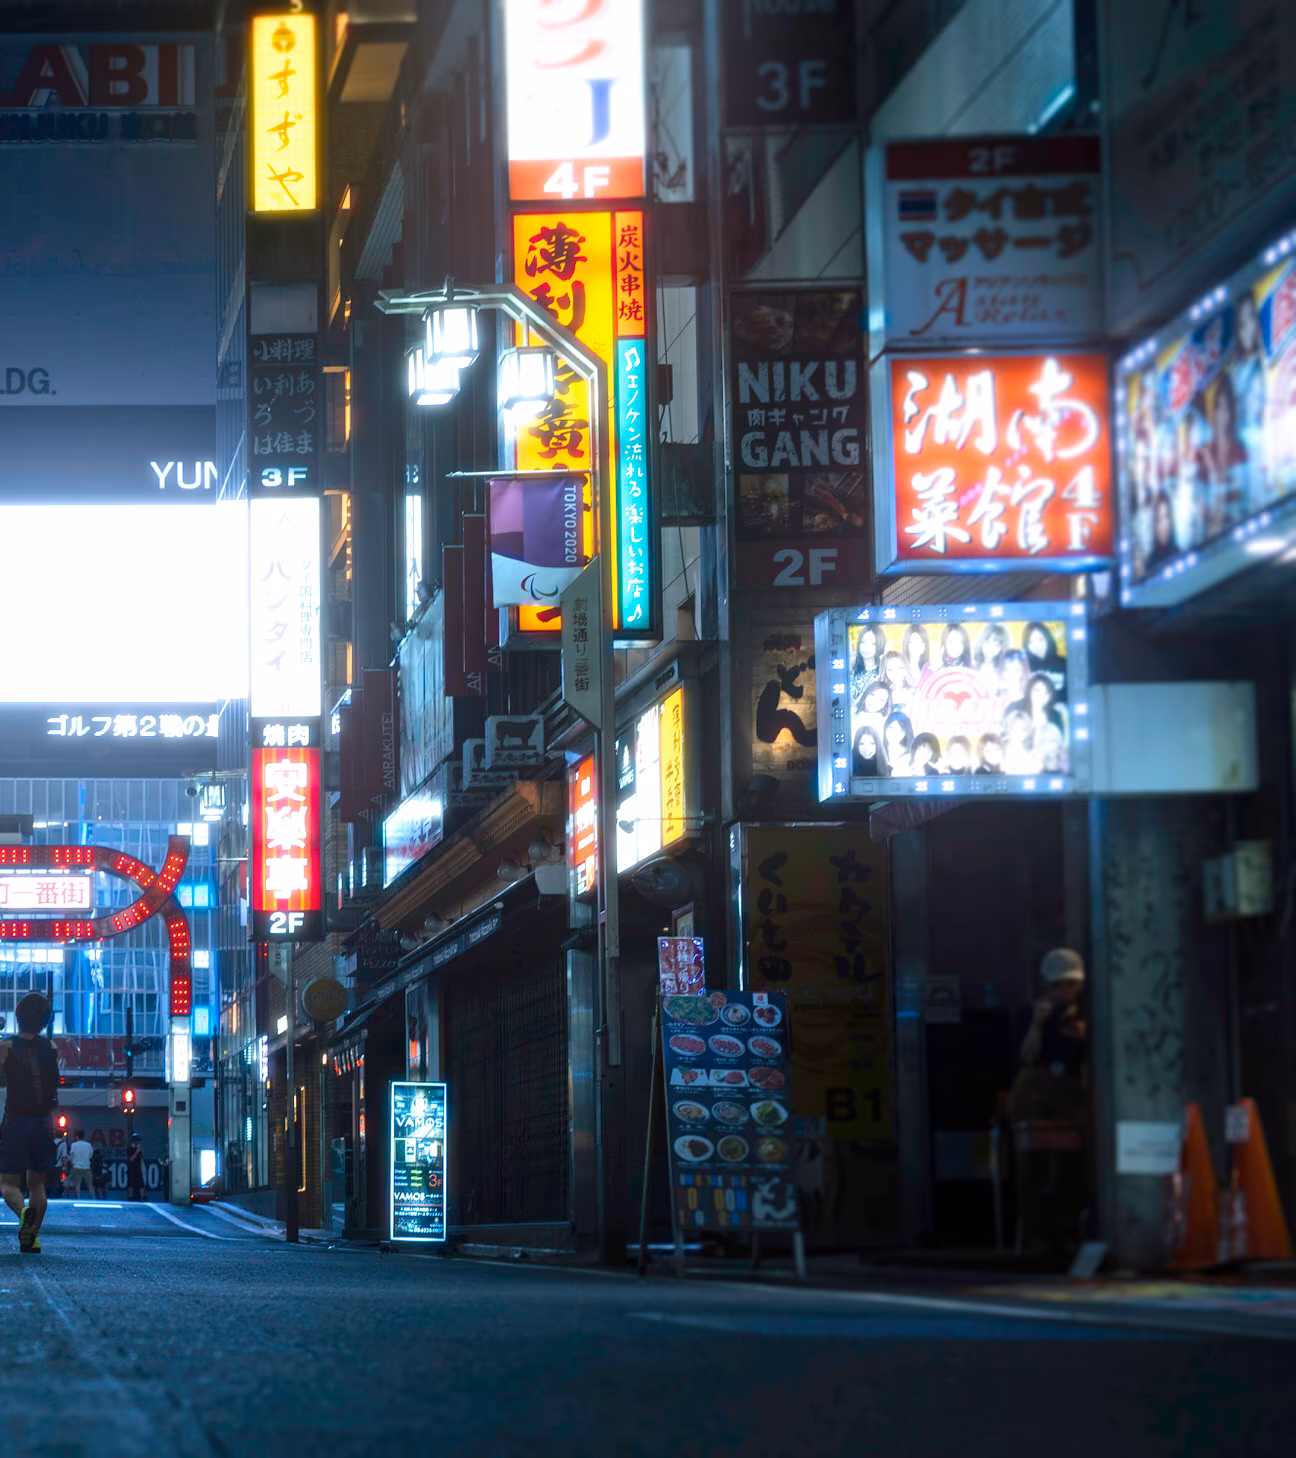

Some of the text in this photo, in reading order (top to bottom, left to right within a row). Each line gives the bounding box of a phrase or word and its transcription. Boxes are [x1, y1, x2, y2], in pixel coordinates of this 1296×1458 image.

[756, 60, 827, 112] 3F
[267, 60, 304, 206] すずや
[968, 146, 1017, 172] 2F
[543, 161, 611, 199] 4F
[618, 225, 643, 321] 炭火串焼
[253, 339, 315, 362] 小料理
[738, 360, 857, 404] NIKU
[748, 407, 851, 426] 肉ギャング
[904, 358, 1098, 460] 湖南
[740, 428, 860, 468] GANG
[261, 467, 309, 487] 3F
[564, 484, 577, 564] TOKYO 2020
[904, 467, 1057, 556] 菜館
[1061, 466, 1102, 553] 4F
[772, 548, 838, 586] 2F
[262, 723, 310, 747] 焼肉
[269, 912, 304, 934] 2F
[757, 852, 793, 982] くいもの
[395, 1117, 443, 1128] VAMOS
[826, 1087, 882, 1122] B1
[394, 1192, 426, 1201] VAMOS
[429, 1174, 443, 1188] 3F
